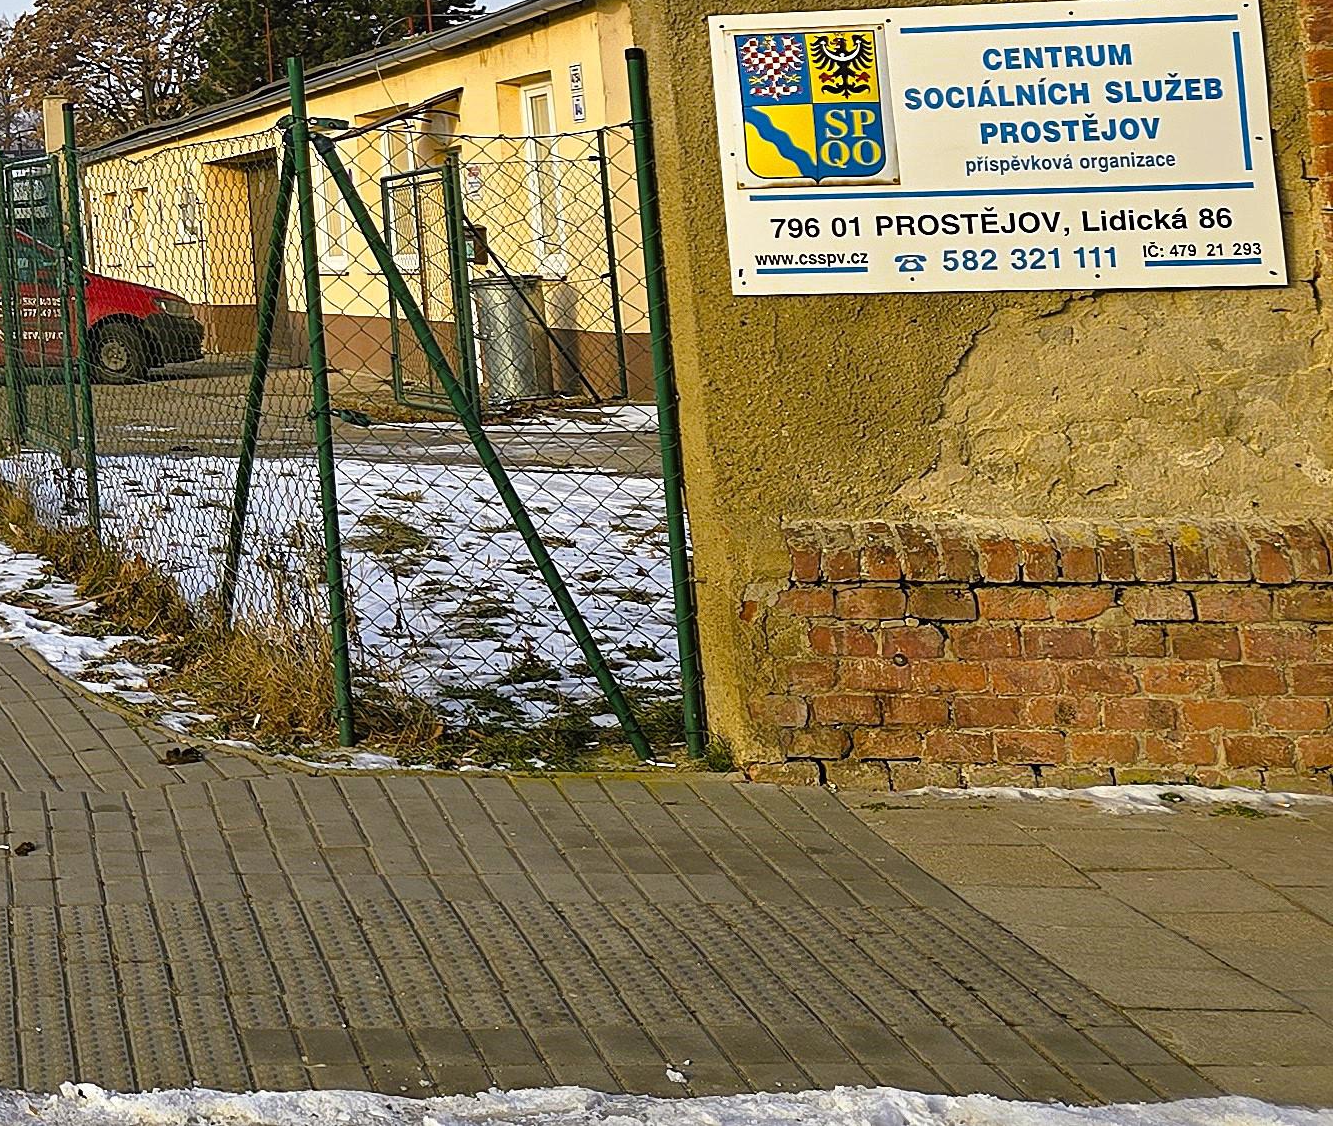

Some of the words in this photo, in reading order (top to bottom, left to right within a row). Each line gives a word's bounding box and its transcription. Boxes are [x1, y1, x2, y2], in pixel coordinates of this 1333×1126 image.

[983, 43, 1133, 71] CENTRUM
[904, 77, 1090, 110] SOCIÁLNÍCH
[1105, 72, 1224, 104] SLUŽEB
[825, 109, 876, 138] SP
[980, 113, 1160, 145] PROSTĚJOV
[820, 139, 882, 169] QO
[965, 152, 1073, 176] příspěvková
[1079, 152, 1176, 171] organizace
[770, 217, 820, 239] 796
[831, 216, 861, 237] 01
[875, 206, 1070, 236] PROSTĚJOV,
[1082, 207, 1188, 232] Lidická
[1199, 207, 1233, 229] 86
[754, 252, 869, 267] www.csspv.cz
[943, 249, 999, 271] 582
[1010, 247, 1061, 270] 321
[1073, 246, 1117, 268] 111
[1143, 241, 1164, 258] IČ:
[1169, 244, 1197, 257] 479
[1206, 243, 1224, 256] 21
[1232, 242, 1262, 256] 293
